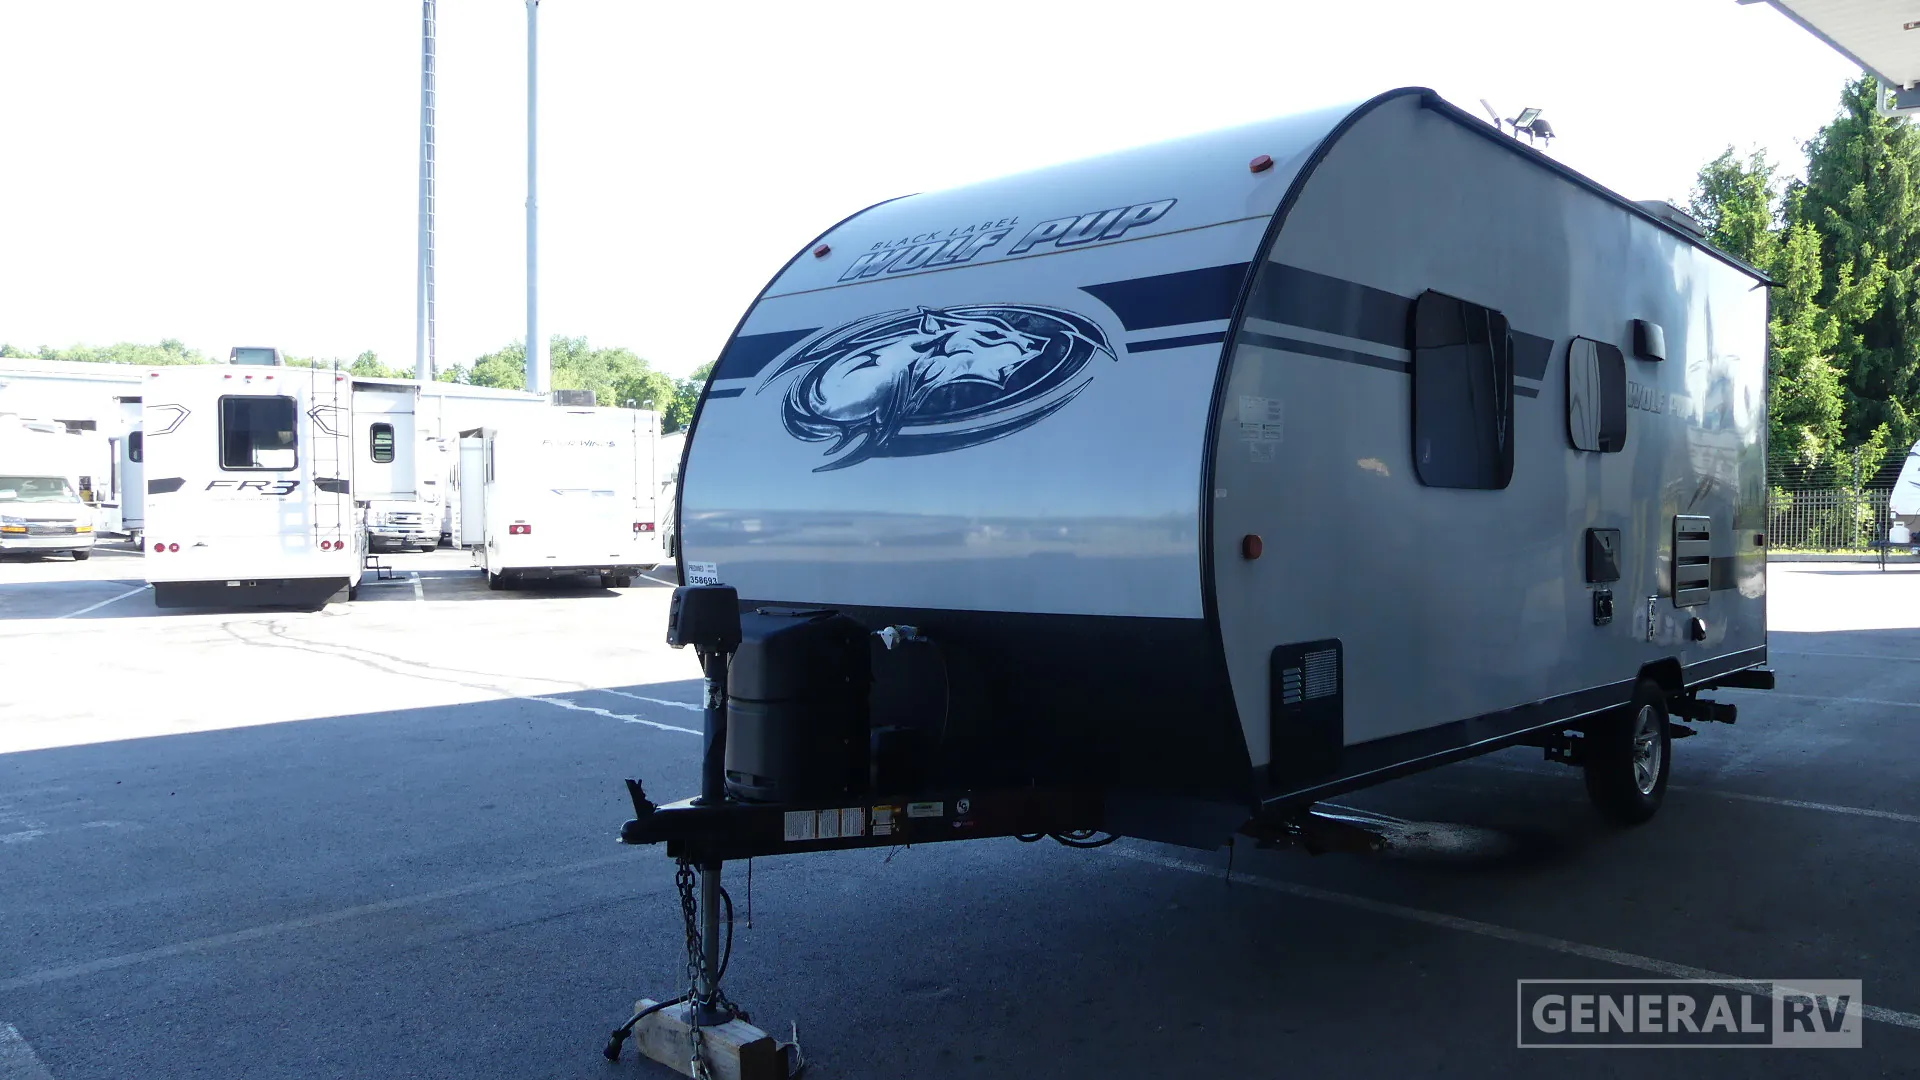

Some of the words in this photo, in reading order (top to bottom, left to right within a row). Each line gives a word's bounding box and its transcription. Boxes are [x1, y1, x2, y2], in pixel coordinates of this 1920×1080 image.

[837, 227, 1014, 283] WOLF
[1007, 198, 1178, 255] PUP
[870, 231, 943, 251] BLACK
[949, 216, 1019, 237] LABEL
[204, 480, 301, 496] FR3
[690, 575, 718, 585] 358693
